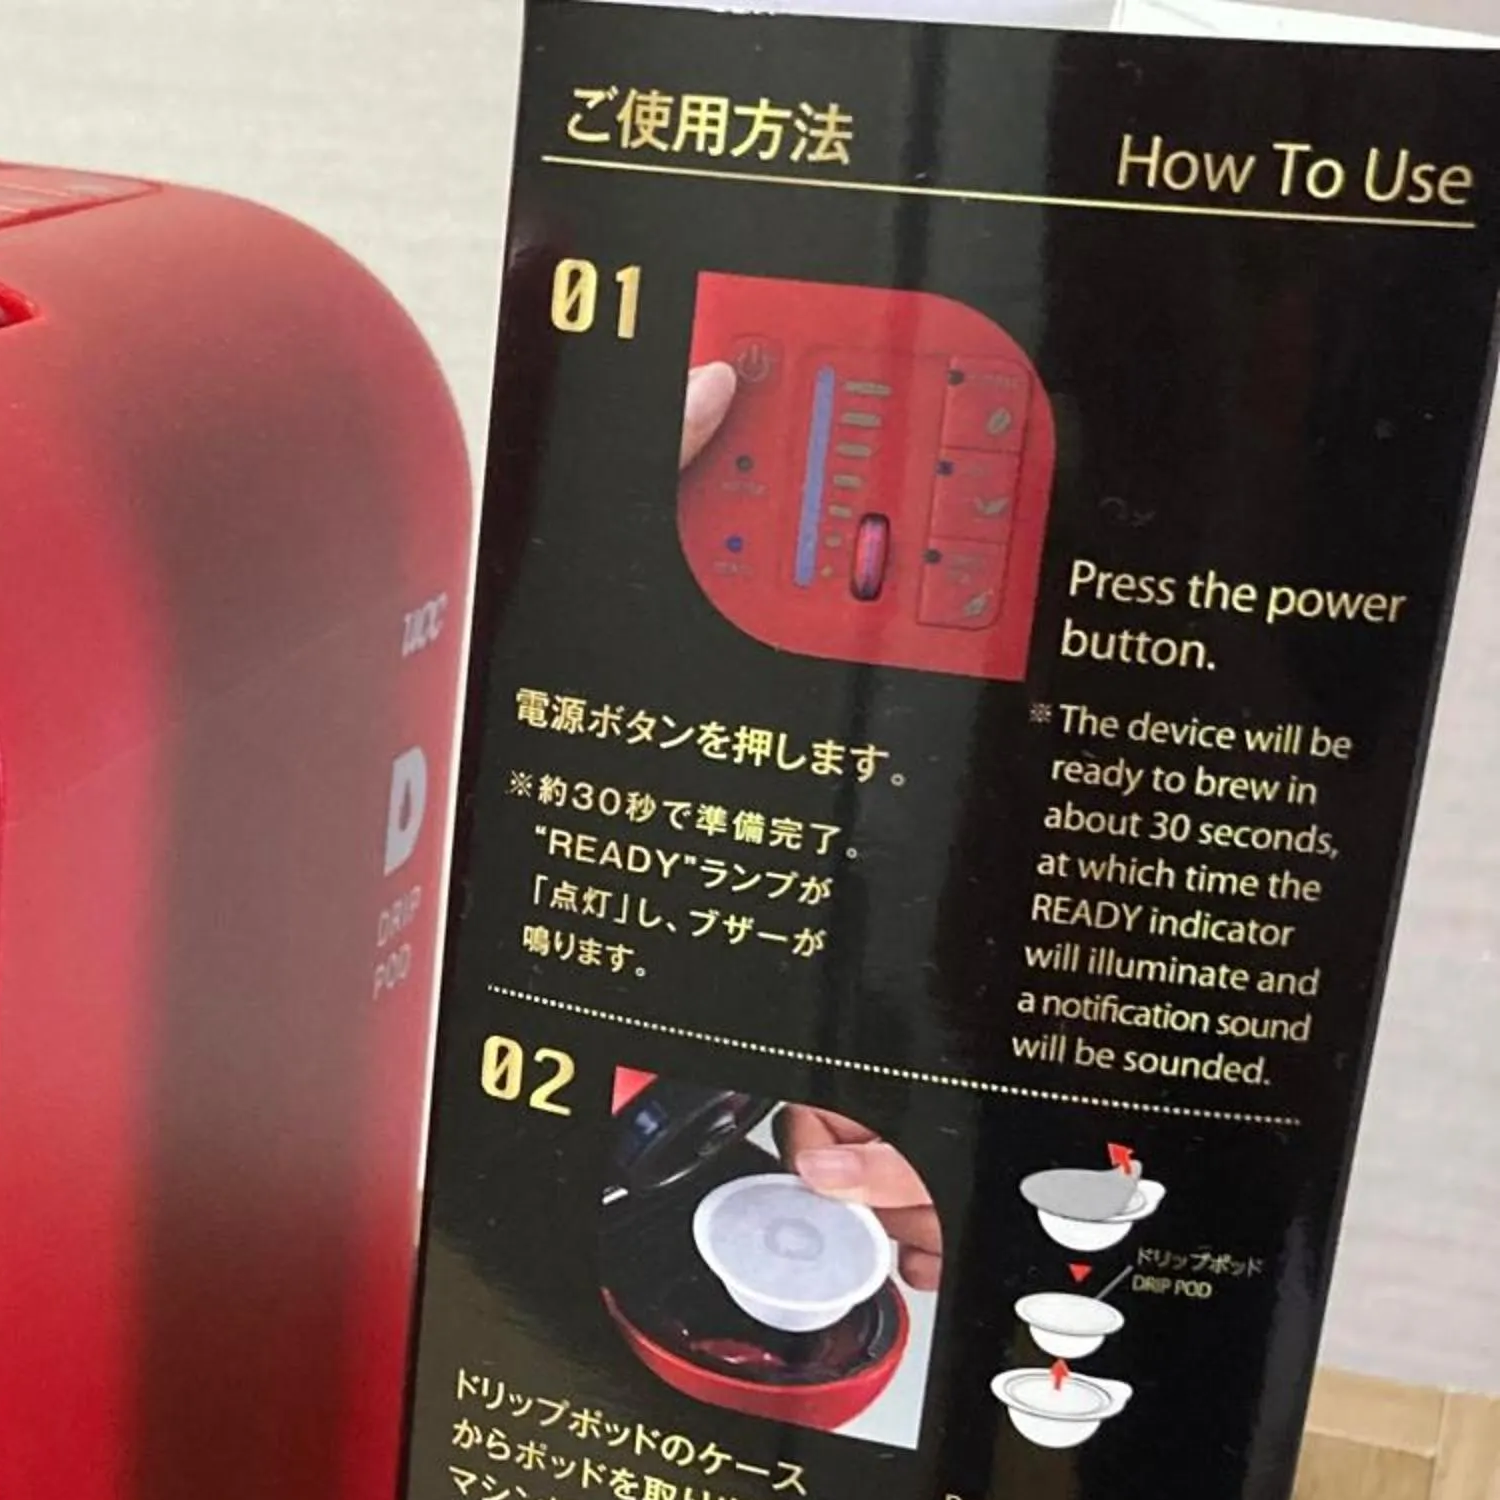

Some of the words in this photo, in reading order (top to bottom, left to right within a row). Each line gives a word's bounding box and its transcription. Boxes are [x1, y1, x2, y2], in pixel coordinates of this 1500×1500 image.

[567, 85, 853, 165] ご使用方法
[1117, 133, 1256, 193] How
[1273, 142, 1345, 199] To
[1365, 147, 1474, 206] Use
[551, 258, 641, 339] 01
[1069, 560, 1177, 606] Press
[1188, 570, 1257, 613] the
[1266, 586, 1406, 625] power
[1061, 618, 1216, 671] button.
[515, 687, 905, 788] 電源ボタンを押します。
[1060, 704, 1119, 739] The
[1127, 712, 1236, 750] device
[1244, 724, 1301, 756] will
[1309, 727, 1353, 759] be
[1051, 758, 1143, 797] ready
[1151, 767, 1186, 793] to
[1195, 766, 1281, 802] brew
[1287, 775, 1317, 805] in
[1043, 801, 1142, 838] about
[1149, 810, 1191, 843] 30
[1199, 821, 1340, 860] seconds,
[1036, 852, 1070, 877] at
[1078, 853, 1176, 890] which
[1184, 863, 1260, 897] time
[1268, 870, 1323, 901] the
[1031, 893, 1143, 932] READY
[1149, 906, 1296, 947] indicator
[521, 923, 647, 978] 鳴ります。
[1024, 943, 1079, 973] will
[1088, 947, 1250, 991] illuminate
[1256, 967, 1322, 997] and
[1016, 992, 1035, 1014] a
[1042, 992, 1210, 1034] notification
[1216, 1013, 1313, 1042] sound
[480, 1034, 576, 1117] 02
[1011, 1034, 1067, 1064] will
[1074, 1037, 1116, 1068] be
[1123, 1049, 1271, 1086] sounded.
[1132, 1274, 1172, 1294] DRIP
[1174, 1279, 1212, 1298] POD
[456, 1368, 808, 1497] ドリップポッドのケース
